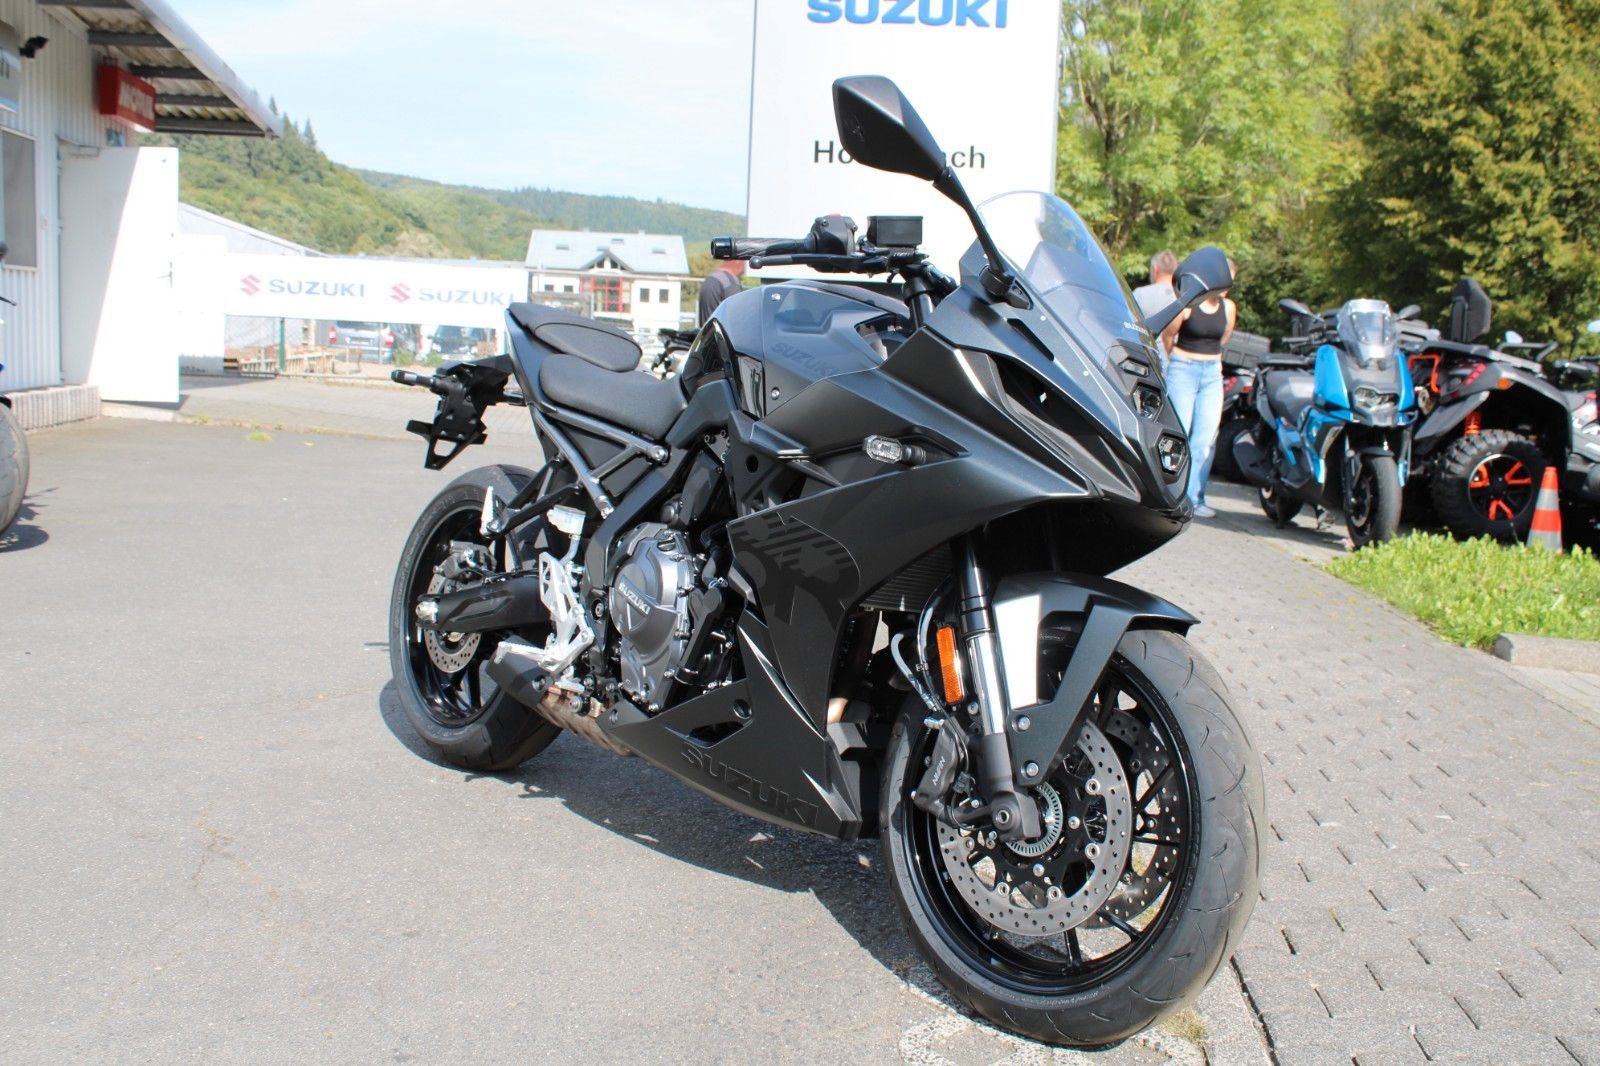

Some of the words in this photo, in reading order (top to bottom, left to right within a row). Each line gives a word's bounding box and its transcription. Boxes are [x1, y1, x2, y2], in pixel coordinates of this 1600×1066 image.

[807, 0, 1008, 28] SUZUKI
[269, 279, 365, 298] SUZUKI
[418, 287, 514, 306] SUZUKI
[618, 582, 651, 615] SUZUKI
[681, 742, 820, 829] SUZUKI
